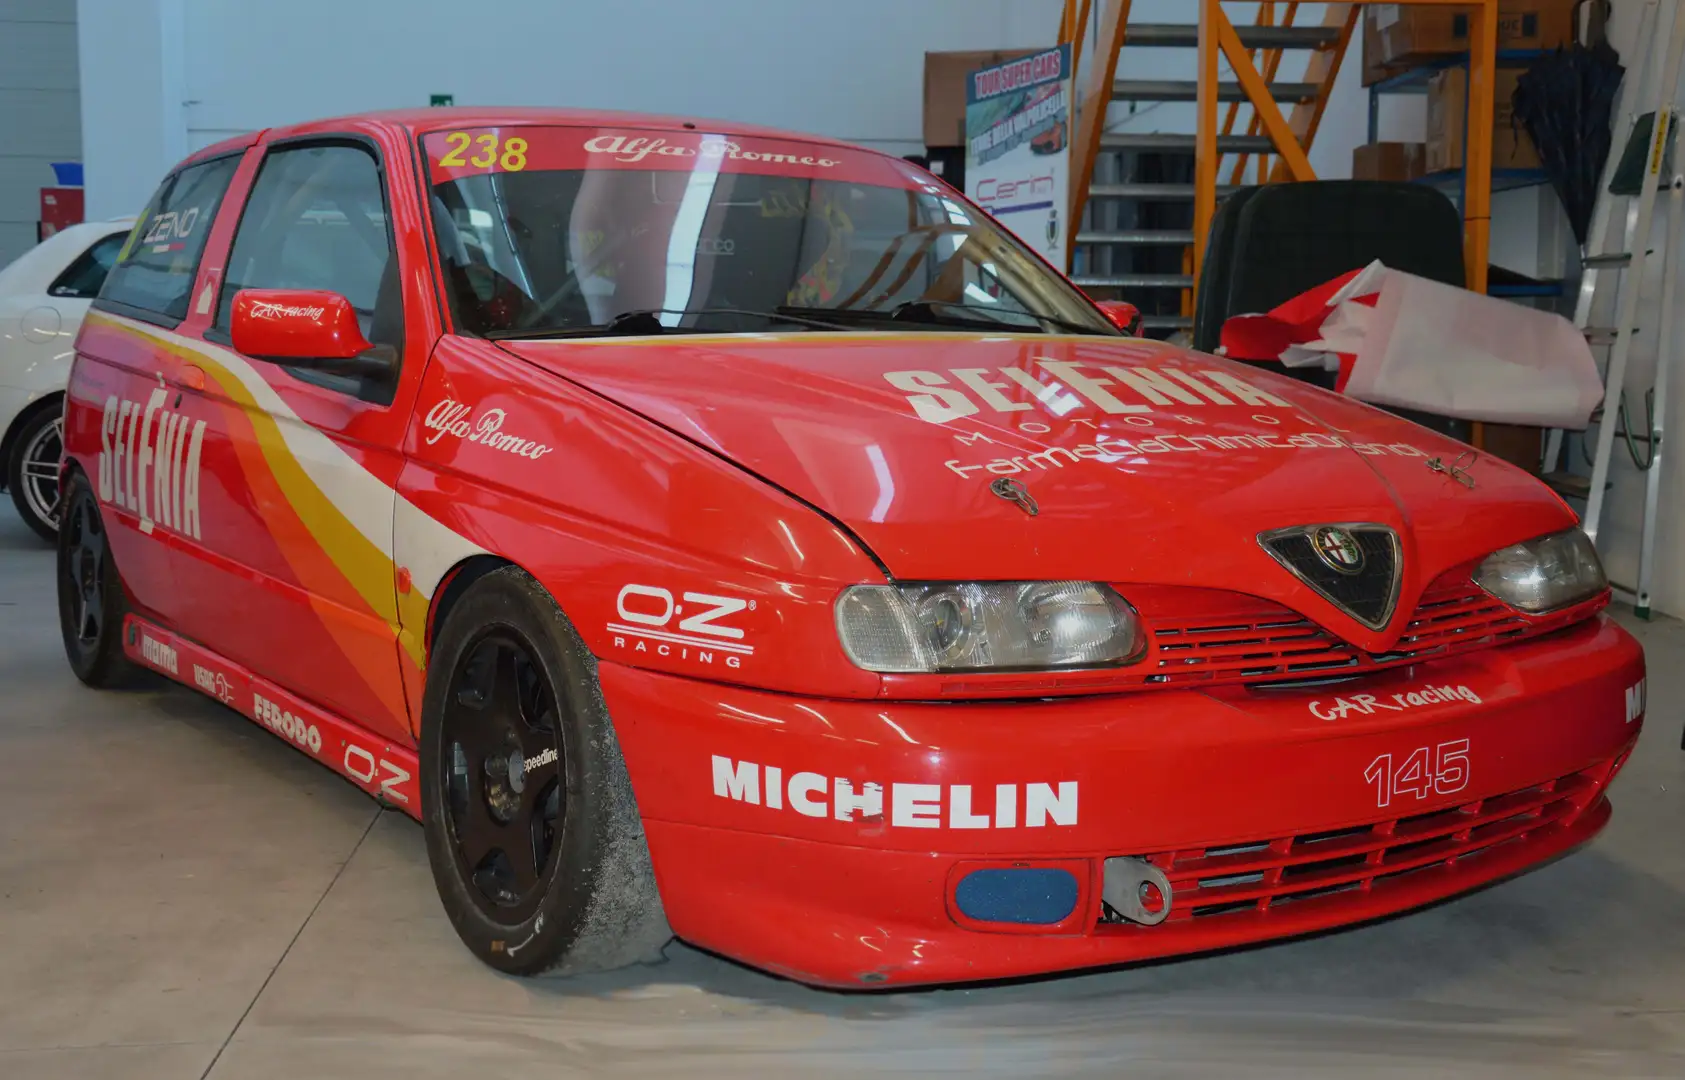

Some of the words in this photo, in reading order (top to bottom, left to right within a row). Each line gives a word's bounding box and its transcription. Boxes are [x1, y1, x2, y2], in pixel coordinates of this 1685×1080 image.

[975, 68, 1001, 99] TOUR
[1001, 58, 1033, 93] SUPER
[1033, 49, 1061, 84] CARS
[439, 132, 528, 171] 238
[583, 136, 696, 162] Alfa
[699, 139, 841, 167] Romeo
[143, 207, 199, 243] ZENO
[250, 300, 284, 319] CAR
[284, 305, 325, 321] racing
[425, 396, 472, 445] Alfa
[468, 408, 553, 460] Romeo
[953, 414, 1206, 447] MOTOR
[614, 636, 741, 669] RACING
[1308, 693, 1404, 721] CAR
[1392, 684, 1483, 708] racing
[253, 692, 323, 755] FERODO
[711, 754, 1079, 829] MICHELIN
[1364, 738, 1470, 808] 145
